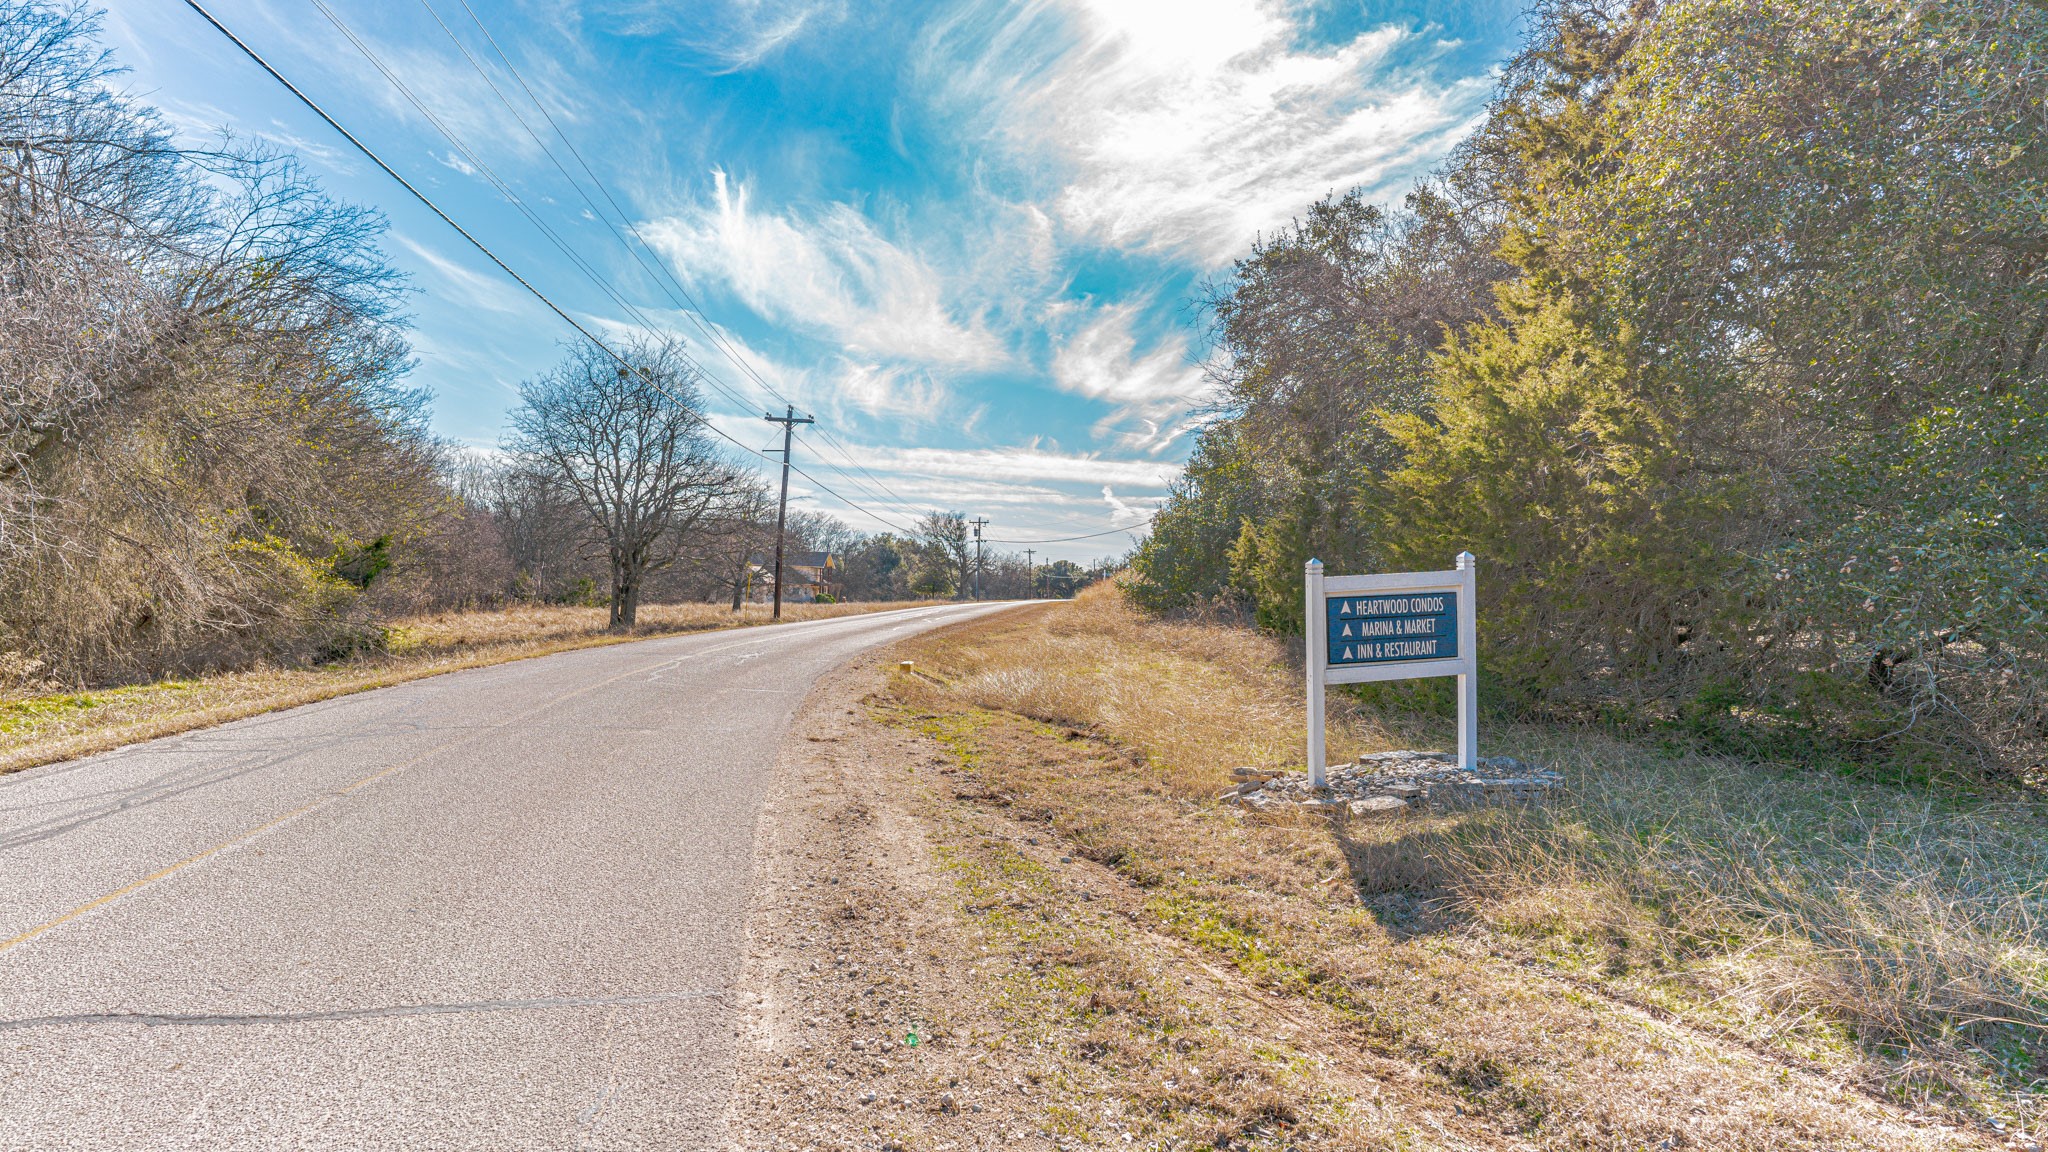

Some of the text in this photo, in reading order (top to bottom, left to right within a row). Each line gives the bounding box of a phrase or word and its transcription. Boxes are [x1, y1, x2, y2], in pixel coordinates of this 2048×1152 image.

[1356, 597, 1444, 615] HEARTWOOD CONDOS
[1362, 618, 1436, 636] MARINA & MARKET
[1357, 640, 1437, 659] INN & RESTAURANT
